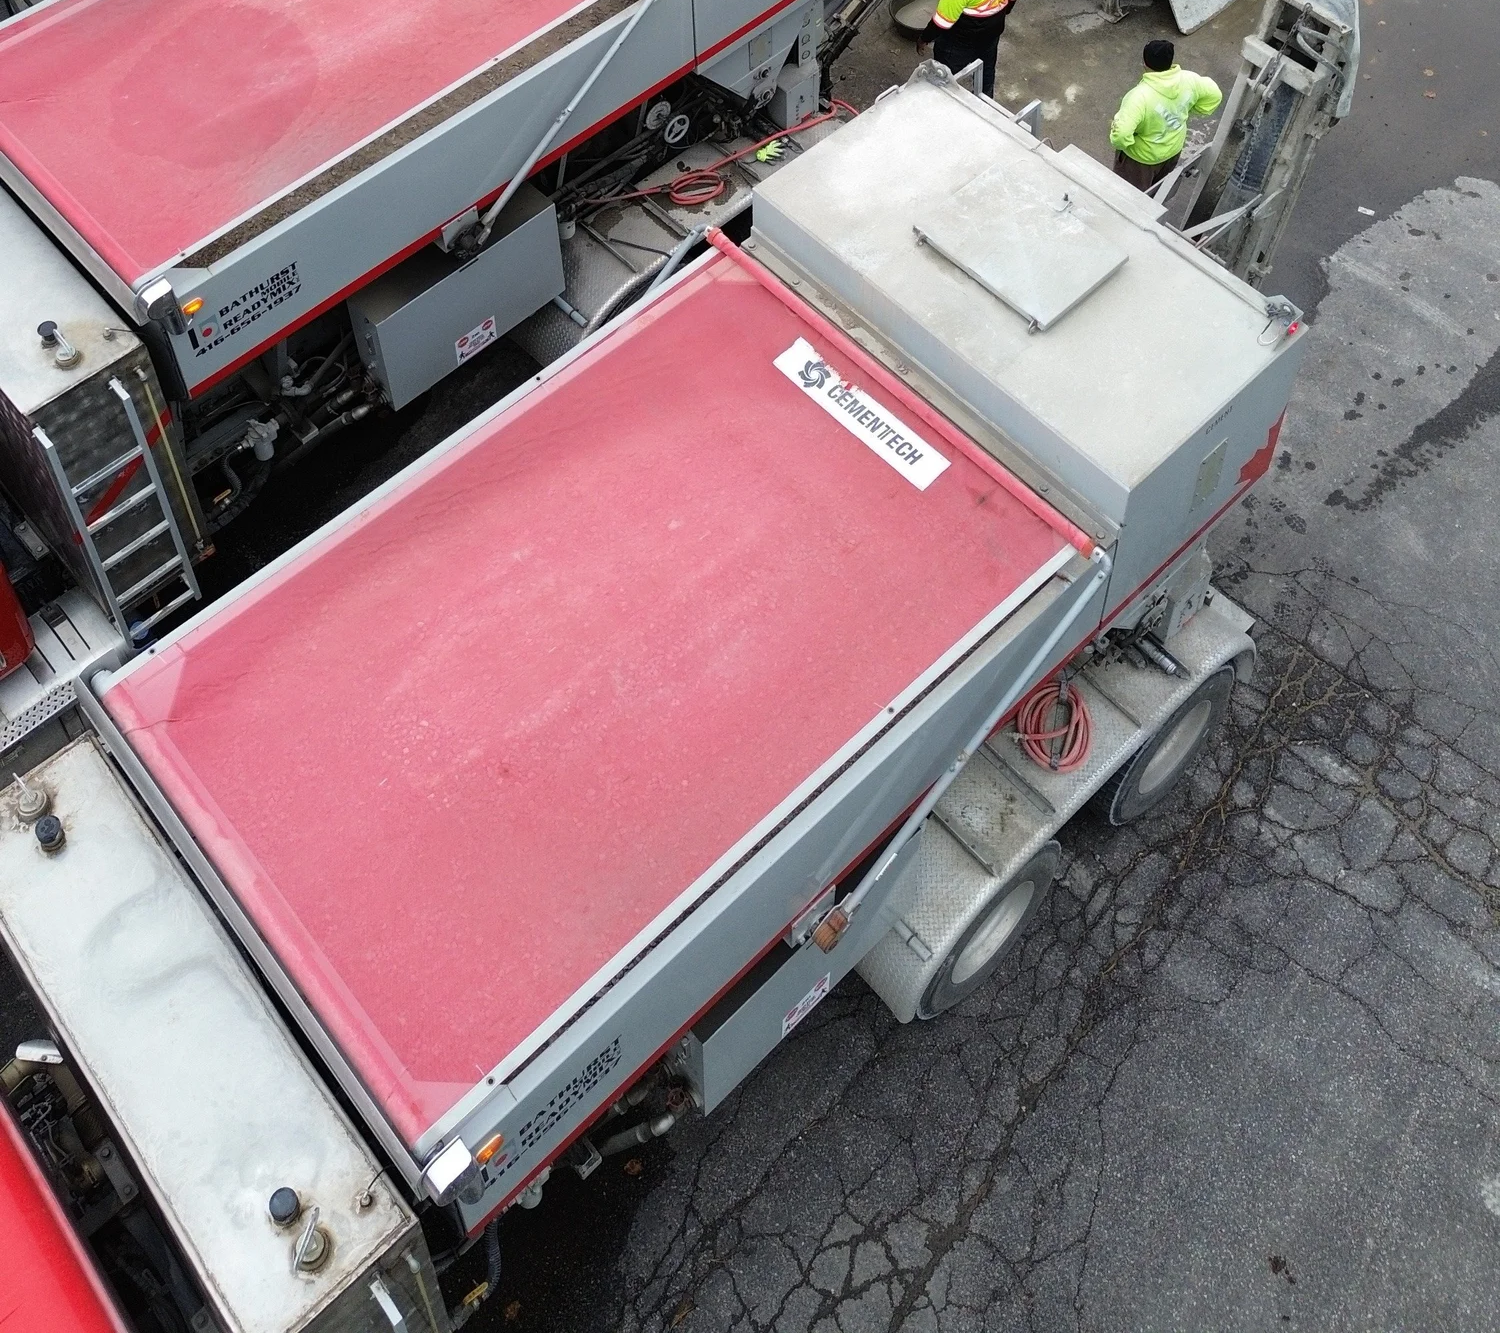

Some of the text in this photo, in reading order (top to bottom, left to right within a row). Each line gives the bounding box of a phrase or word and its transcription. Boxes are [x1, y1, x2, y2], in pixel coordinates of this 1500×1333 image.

[219, 261, 298, 318] BATHURST
[222, 277, 297, 331] READYMIX
[260, 269, 299, 297] MOBILE
[195, 283, 302, 358] 416-656-1937
[519, 1034, 622, 1137] BATHURST
[520, 1056, 616, 1147] READYMIX
